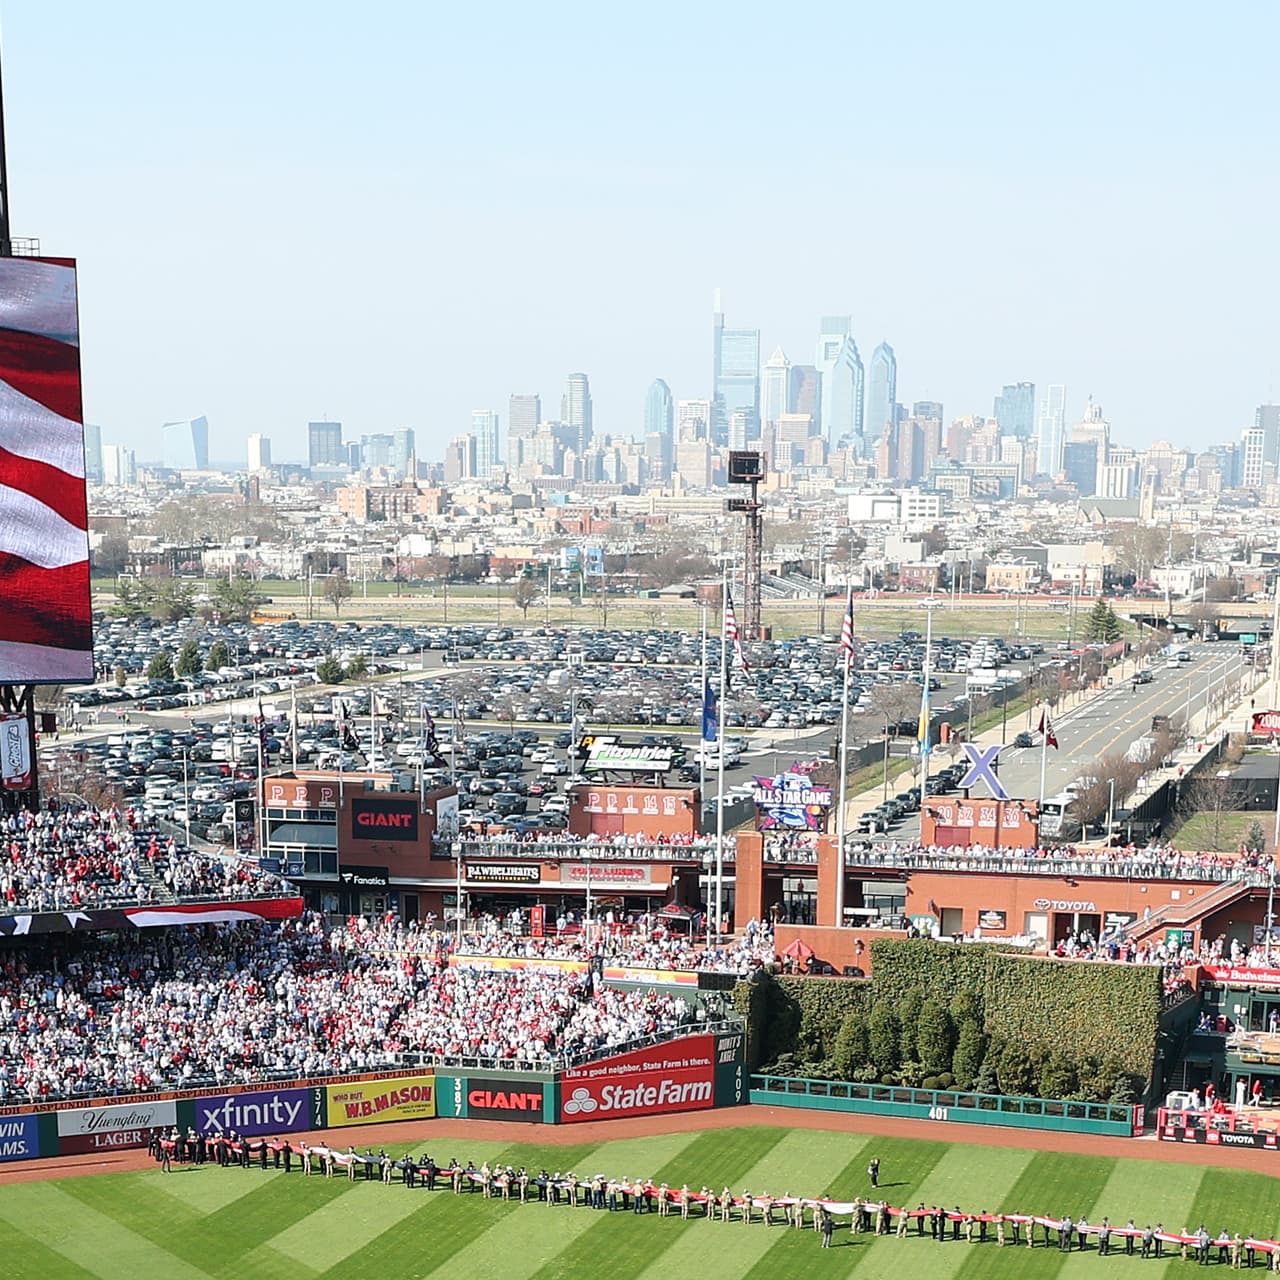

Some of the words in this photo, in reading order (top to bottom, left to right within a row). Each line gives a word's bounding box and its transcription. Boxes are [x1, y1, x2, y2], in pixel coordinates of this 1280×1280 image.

[586, 737, 675, 760] Fitzpatrick
[357, 813, 412, 828] GIANT
[353, 876, 386, 886] Fanatics
[1051, 900, 1096, 912] TOYOTA
[566, 1070, 581, 1078] Like
[589, 1067, 608, 1078] good
[608, 1064, 641, 1076] neighbor,
[643, 1062, 661, 1071] State
[663, 1060, 681, 1068] Farm
[690, 1057, 711, 1066] there.
[32, 1101, 92, 1113] ASPLUNDH
[104, 1094, 161, 1105] ASPLUNDH
[174, 1088, 229, 1099] ASPLUNDH
[241, 1081, 296, 1092] ASPLUNDH
[454, 1079, 462, 1116] 387
[469, 1090, 542, 1110] GIANT
[80, 1107, 154, 1130] Yuengling
[203, 1095, 303, 1132] xfinity
[928, 1107, 948, 1121] 401
[94, 1132, 143, 1148] LAGER
[1221, 1134, 1255, 1145] TOYOTA
